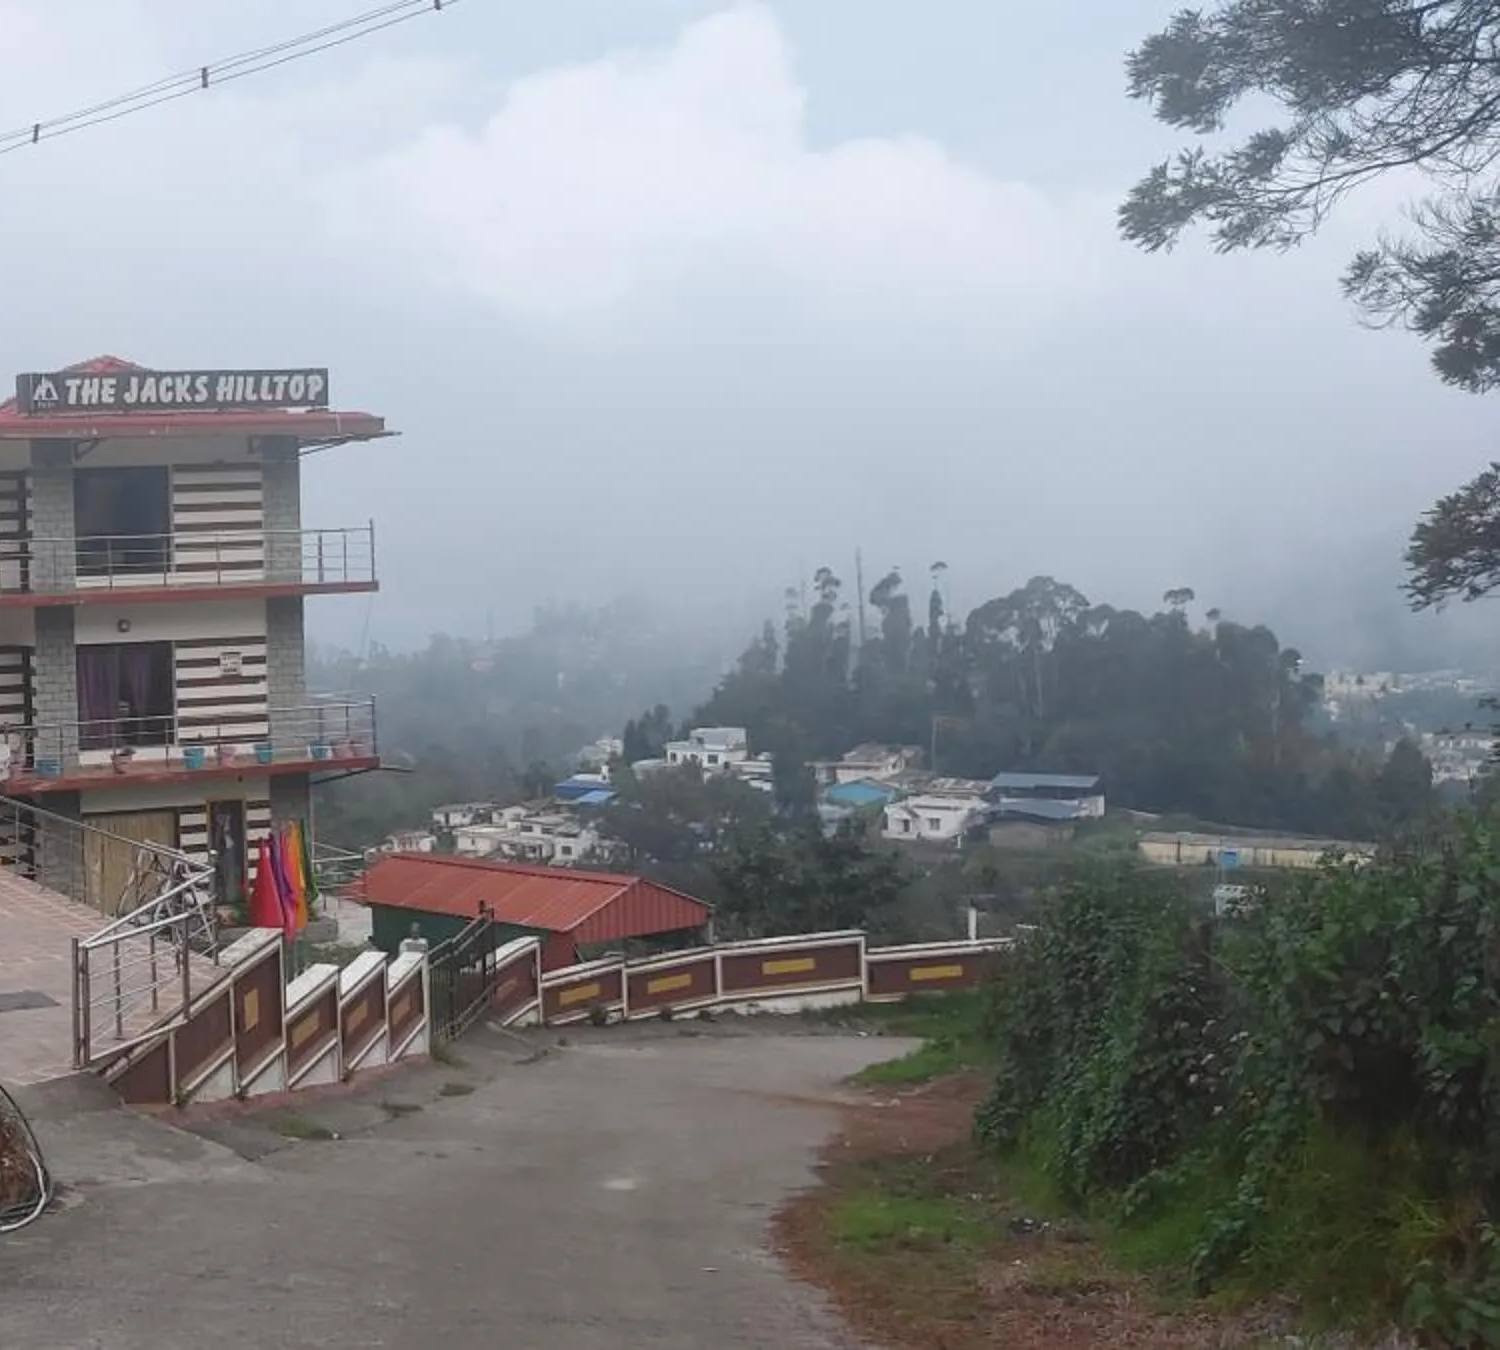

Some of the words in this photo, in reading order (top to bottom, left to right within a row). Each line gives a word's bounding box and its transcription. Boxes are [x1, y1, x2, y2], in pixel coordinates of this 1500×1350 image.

[66, 377, 117, 405] THE
[123, 375, 210, 404] JACKS
[216, 374, 324, 402] HILLTOP
